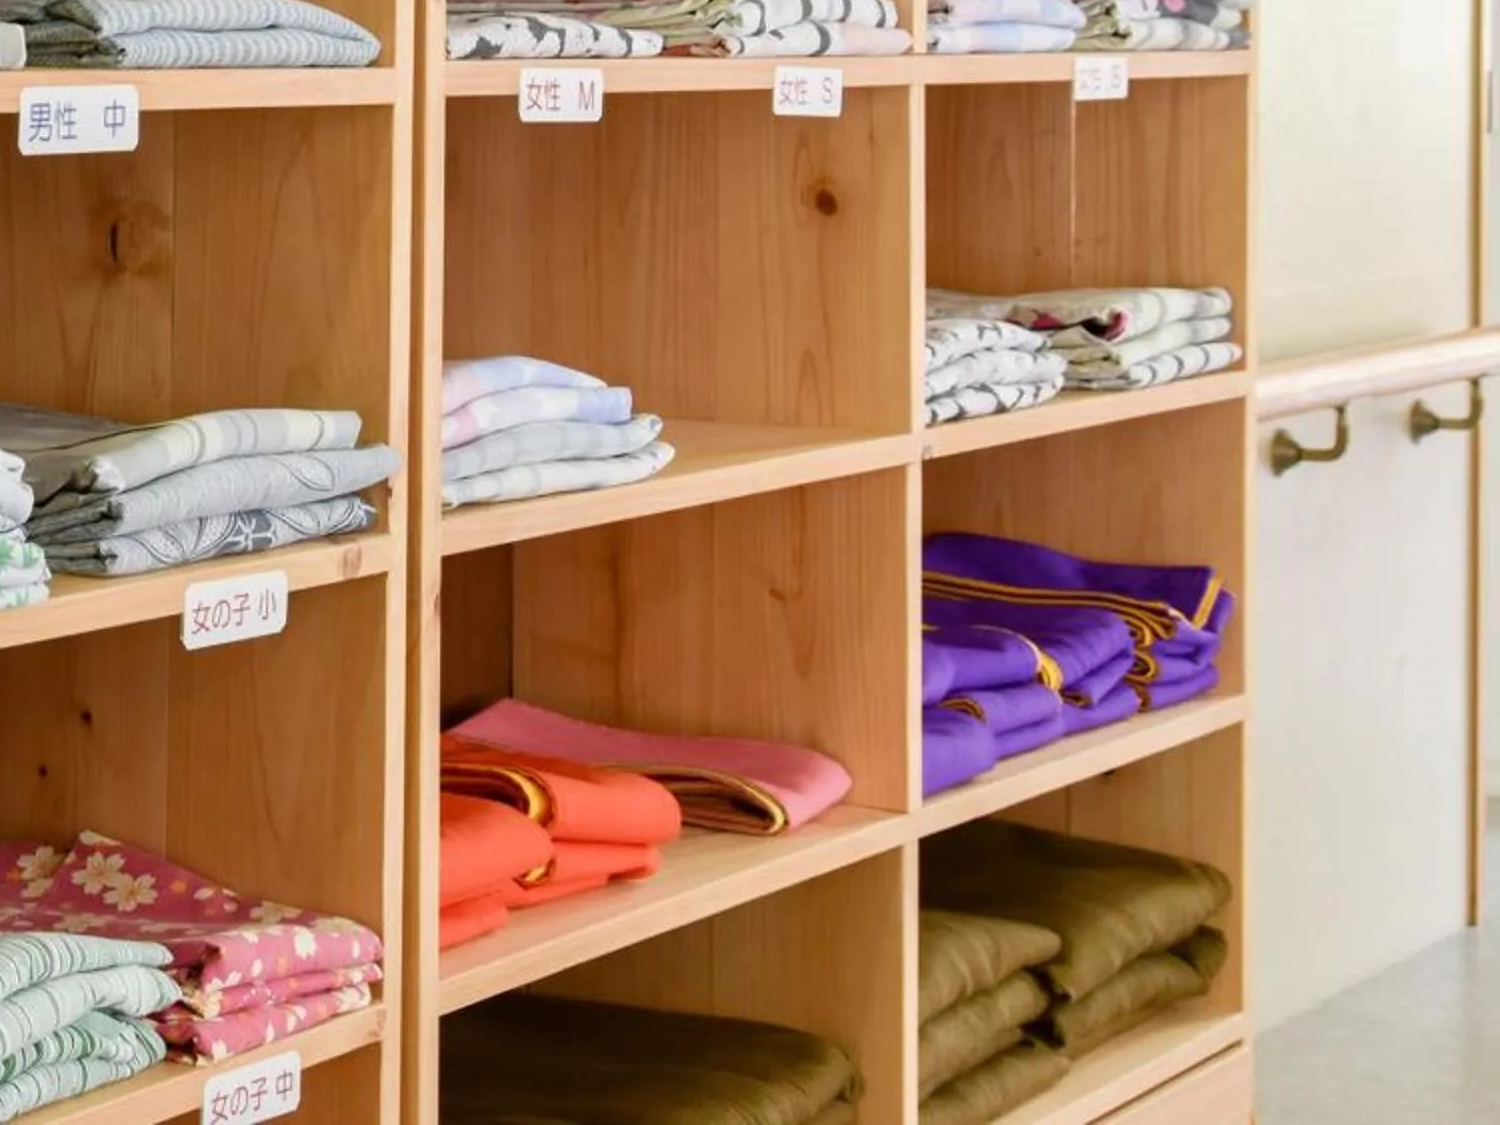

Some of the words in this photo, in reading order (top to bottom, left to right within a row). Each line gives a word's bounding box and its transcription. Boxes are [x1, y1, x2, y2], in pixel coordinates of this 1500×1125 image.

[525, 78, 561, 111] 女性
[578, 80, 595, 111] M
[822, 76, 834, 105] S
[28, 100, 78, 142] 男性
[104, 98, 126, 137] 中
[192, 593, 251, 635] 女の子
[259, 587, 277, 620] 小
[210, 1077, 268, 1125] 女の子
[276, 1067, 293, 1101] 中
